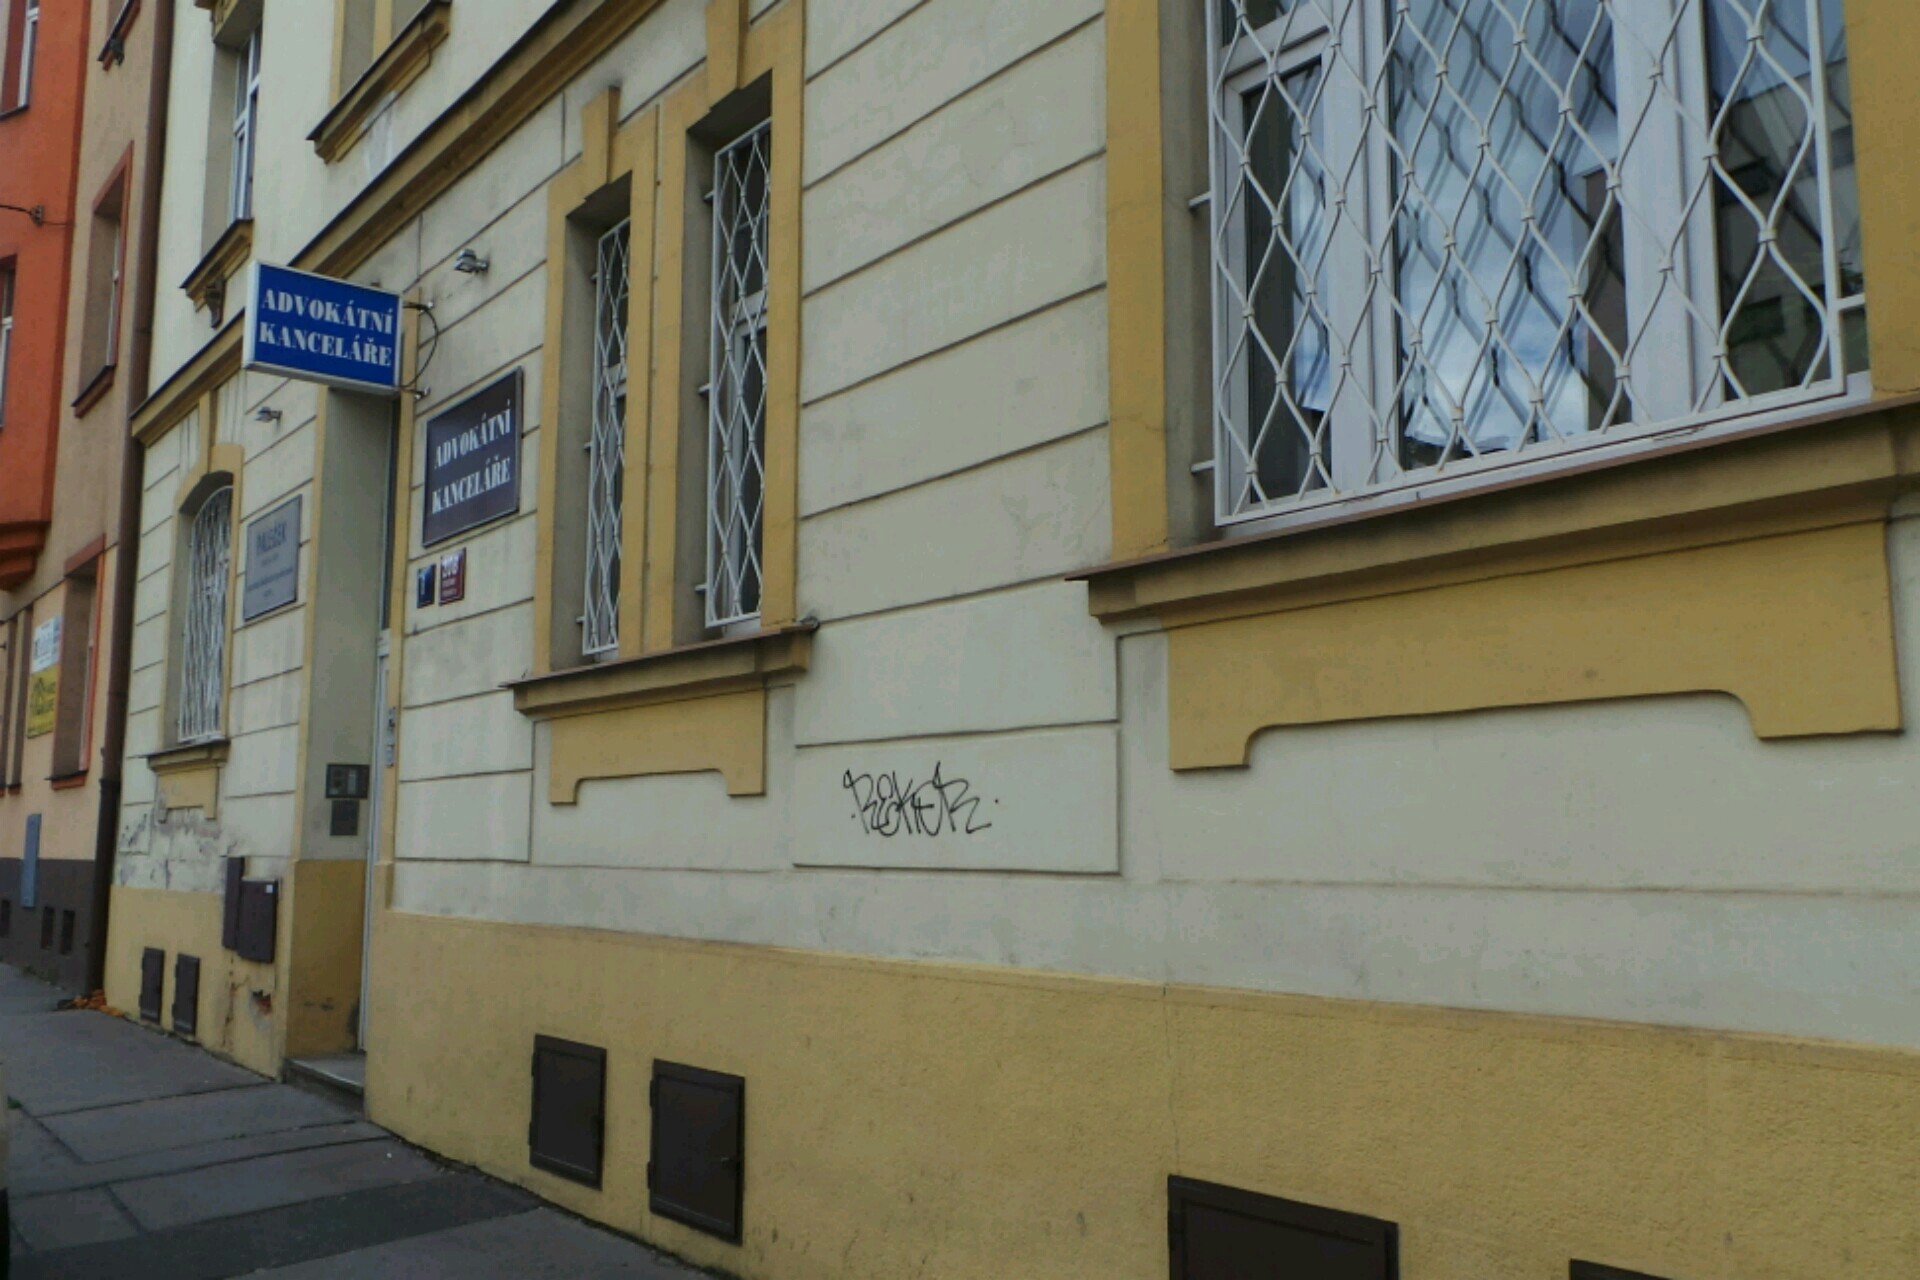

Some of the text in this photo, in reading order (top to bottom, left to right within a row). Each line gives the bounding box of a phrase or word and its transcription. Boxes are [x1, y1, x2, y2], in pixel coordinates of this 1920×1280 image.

[261, 288, 393, 335] ADVOKÁTNÍ
[259, 321, 392, 367] KANCELÁŘE
[434, 398, 511, 469] ADVOKÁTNÍ
[432, 454, 511, 514] KANCELÁŘE
